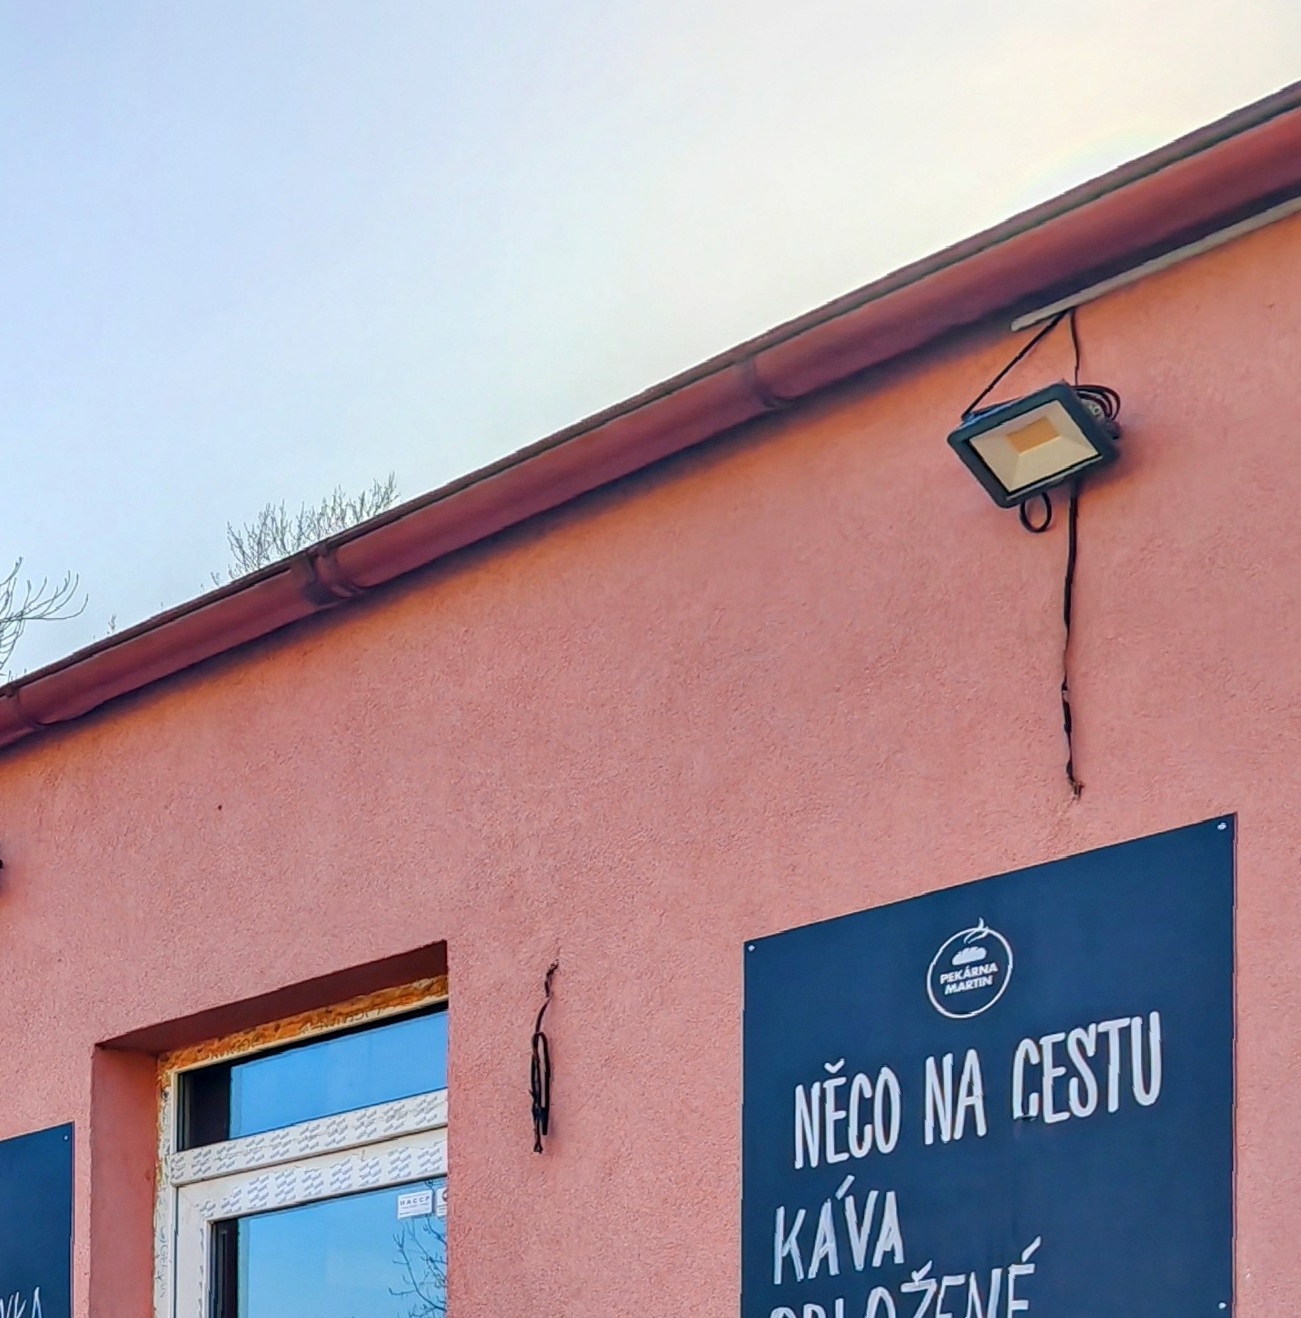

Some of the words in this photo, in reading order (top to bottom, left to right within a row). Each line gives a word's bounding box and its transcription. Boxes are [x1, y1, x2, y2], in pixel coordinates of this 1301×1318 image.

[940, 962, 999, 985] PEKÁRNA
[944, 974, 994, 995] MARTIN
[794, 1057, 902, 1170] NĚCO
[923, 1048, 987, 1146] NA
[1011, 1010, 1163, 1125] CESTU
[772, 1174, 905, 1286] KÁVA
